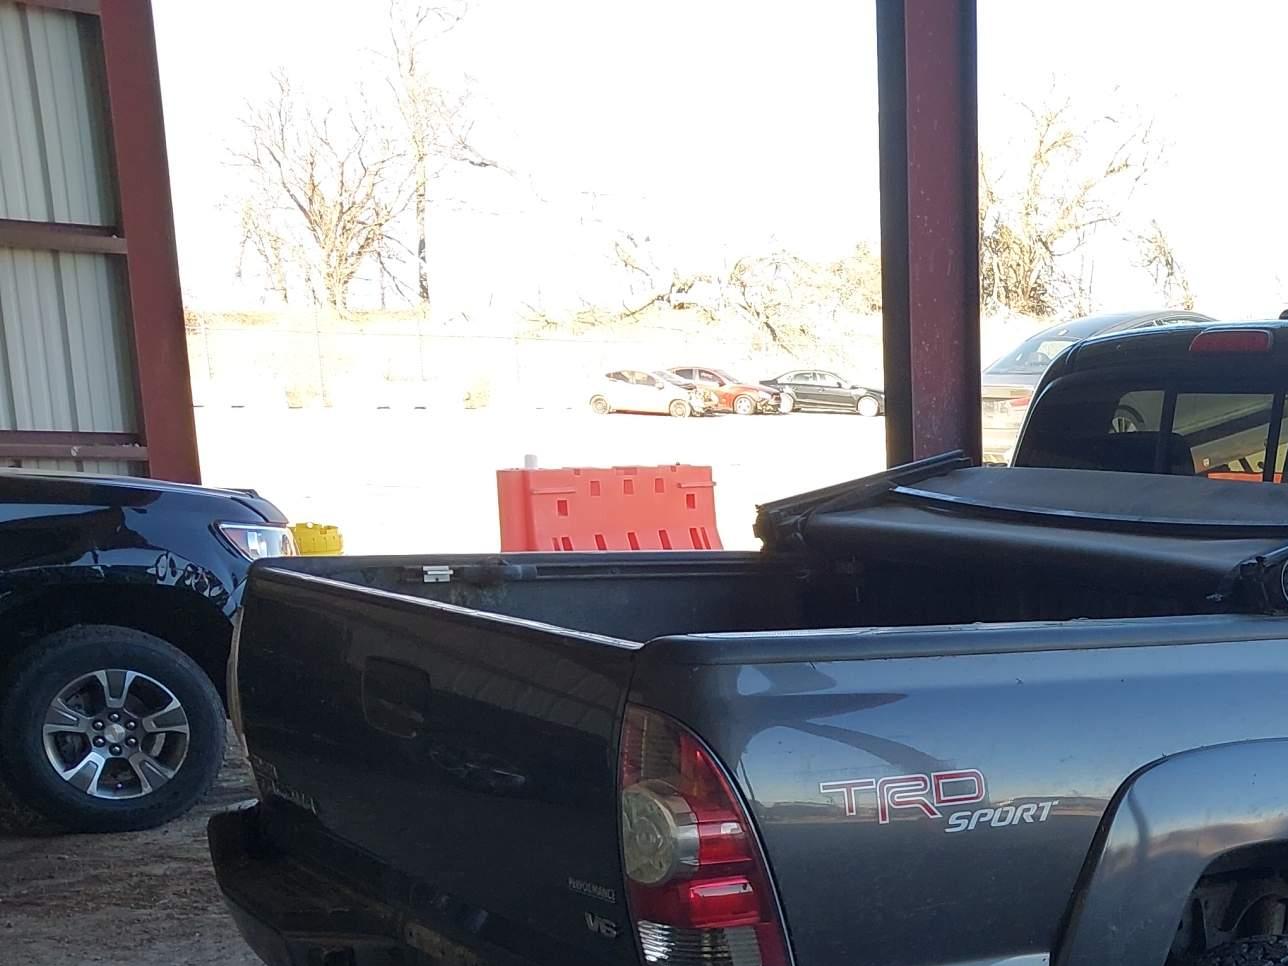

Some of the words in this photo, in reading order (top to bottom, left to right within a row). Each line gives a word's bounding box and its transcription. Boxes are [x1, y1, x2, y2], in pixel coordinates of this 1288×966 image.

[820, 769, 986, 824] TRD
[945, 801, 1059, 832] SPORT
[584, 911, 617, 938] V6
